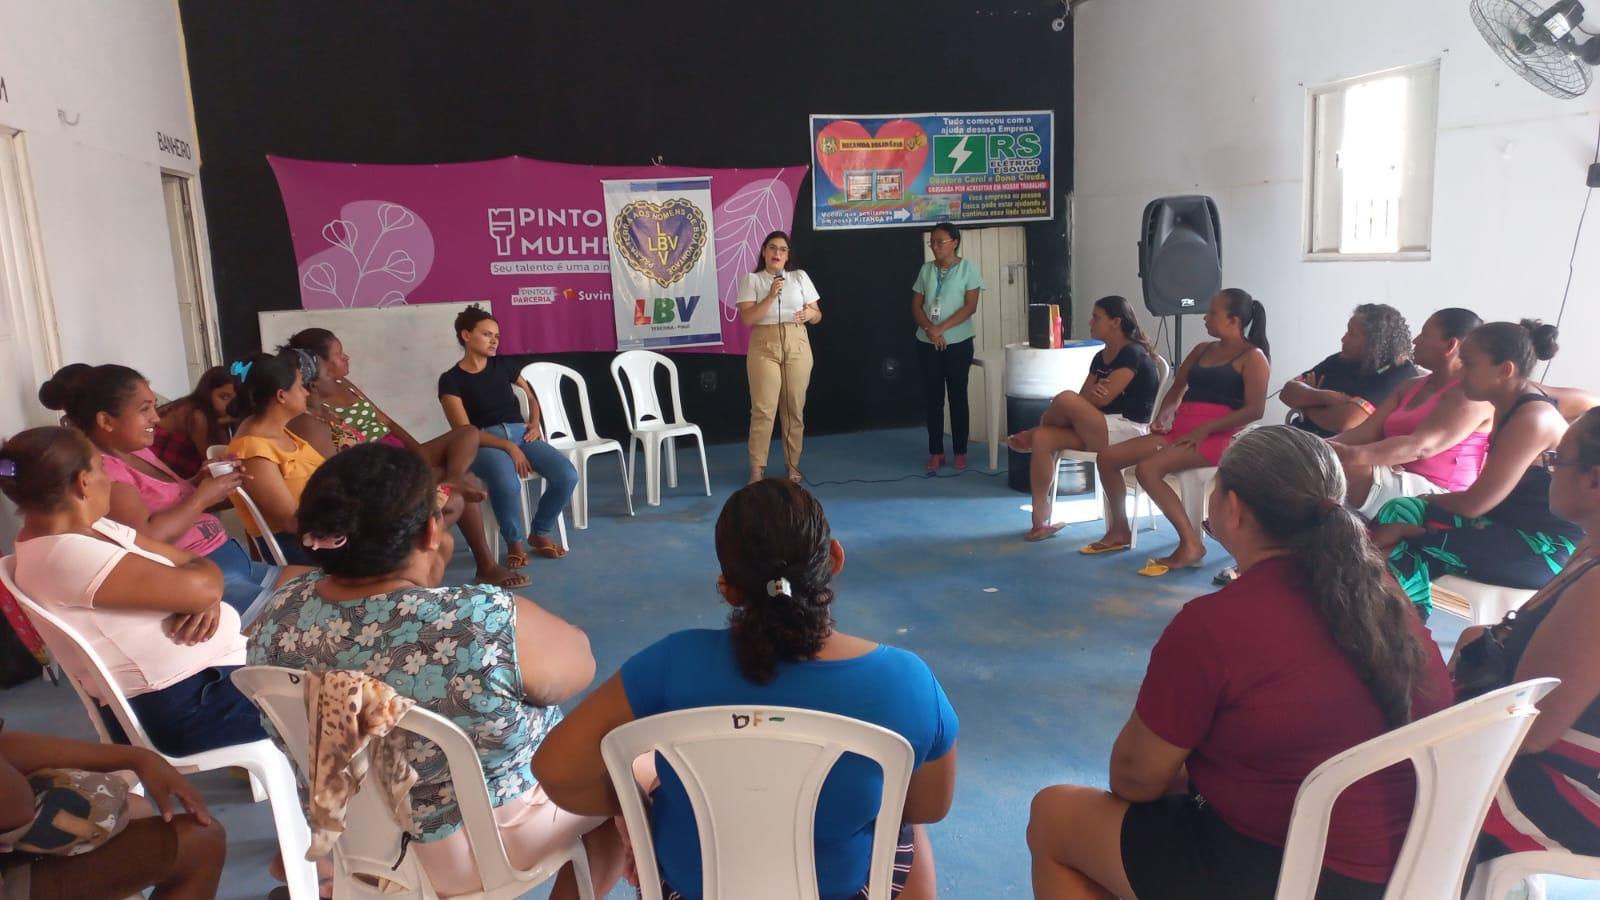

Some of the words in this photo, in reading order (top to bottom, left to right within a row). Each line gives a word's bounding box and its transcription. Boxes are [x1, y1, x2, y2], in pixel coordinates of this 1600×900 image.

[943, 117, 964, 126] Tudo
[966, 117, 1004, 126] começou
[941, 125, 964, 135] ajuda
[998, 124, 1034, 133] Empresa
[157, 131, 191, 160] BANHEIRO
[989, 132, 1042, 160] RS
[995, 174, 1016, 182] Dona
[519, 208, 603, 228] PINTO
[652, 208, 686, 221] HOMENS
[648, 234, 678, 251] LBV
[493, 264, 512, 273] Seu
[515, 263, 554, 273] talento
[556, 262, 563, 272] é
[566, 264, 590, 272] uma
[520, 288, 552, 296] PINTOU
[578, 290, 611, 301] Suvin
[513, 296, 552, 304] PARCERIA
[633, 295, 701, 326] LBV
